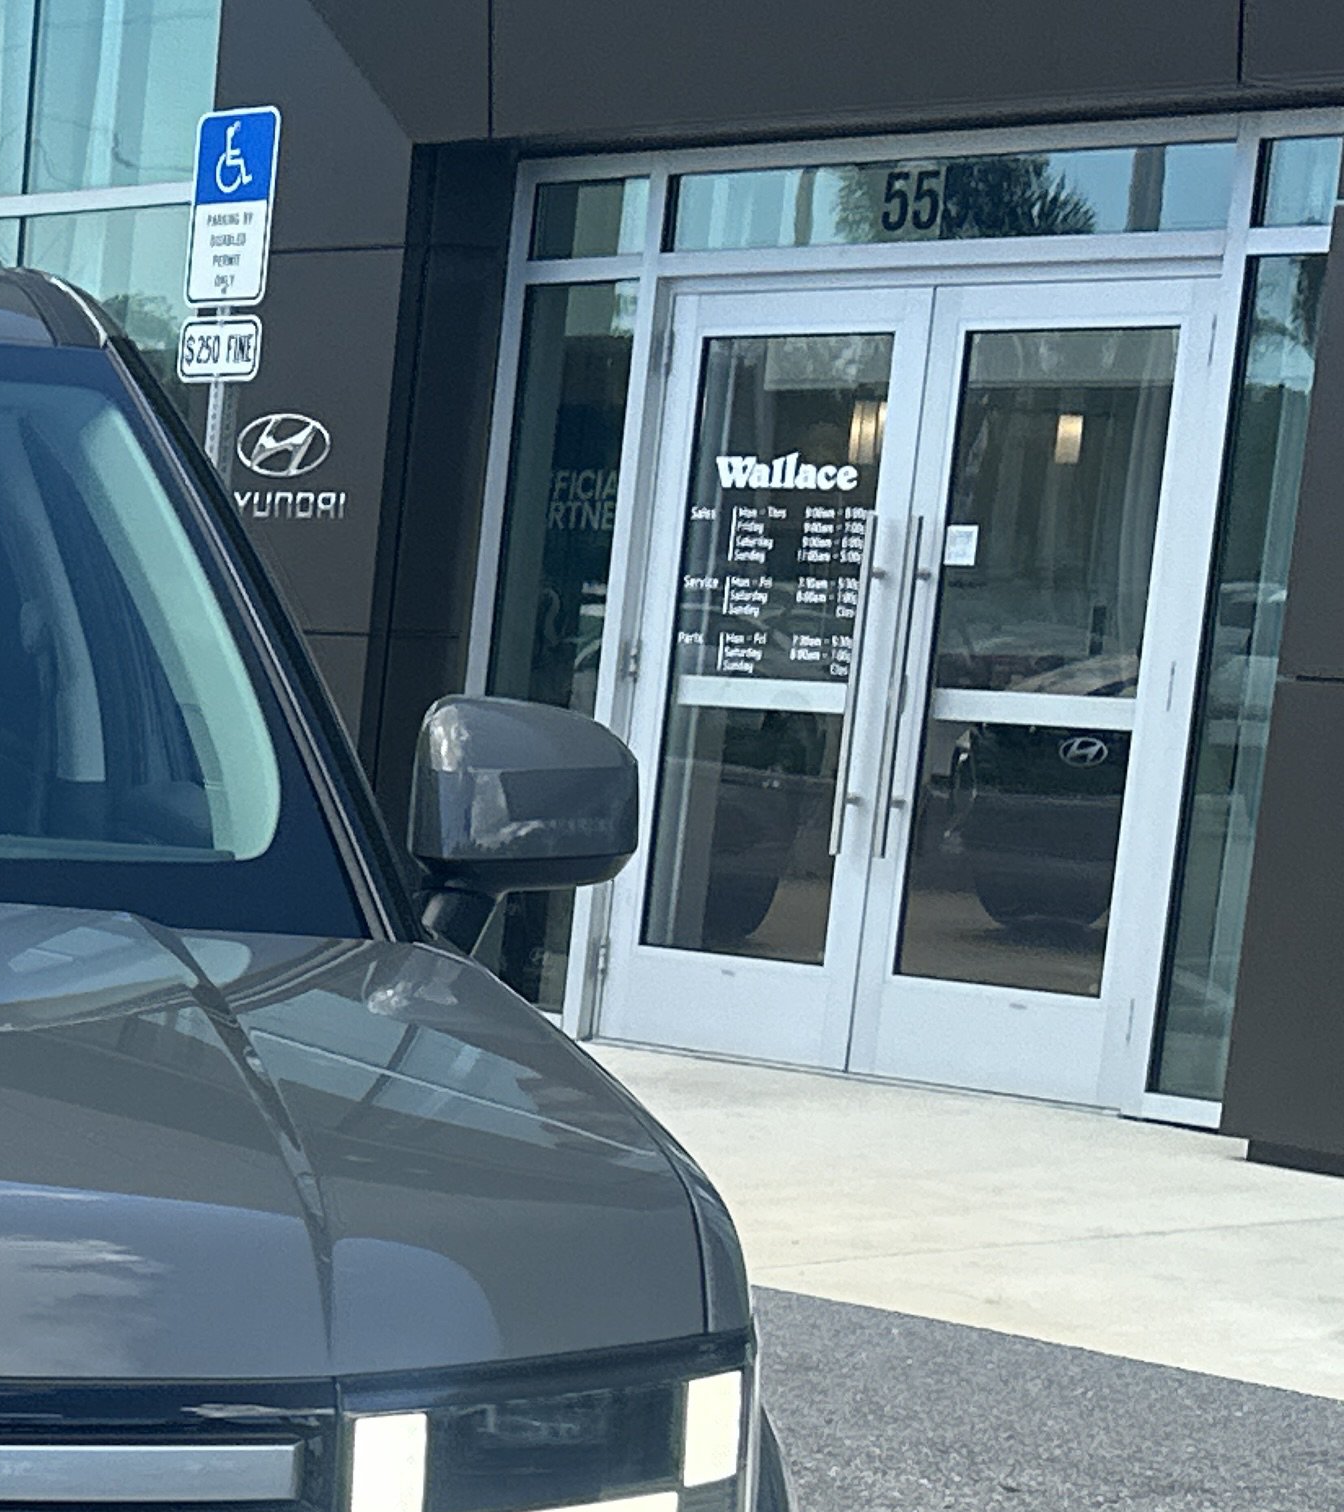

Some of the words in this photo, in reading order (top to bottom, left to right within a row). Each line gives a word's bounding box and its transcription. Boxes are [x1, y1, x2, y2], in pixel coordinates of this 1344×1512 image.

[185, 335, 220, 366] $250
[226, 334, 254, 364] FINE
[716, 451, 860, 491] Wallace
[553, 469, 617, 500] FICIA
[234, 491, 347, 520] YUNDAI
[548, 501, 616, 531] RTNE
[691, 506, 716, 520] Sales
[683, 574, 719, 589] Service
[835, 605, 855, 618] Clos
[678, 631, 704, 644] Parts
[830, 662, 848, 676] Clos
